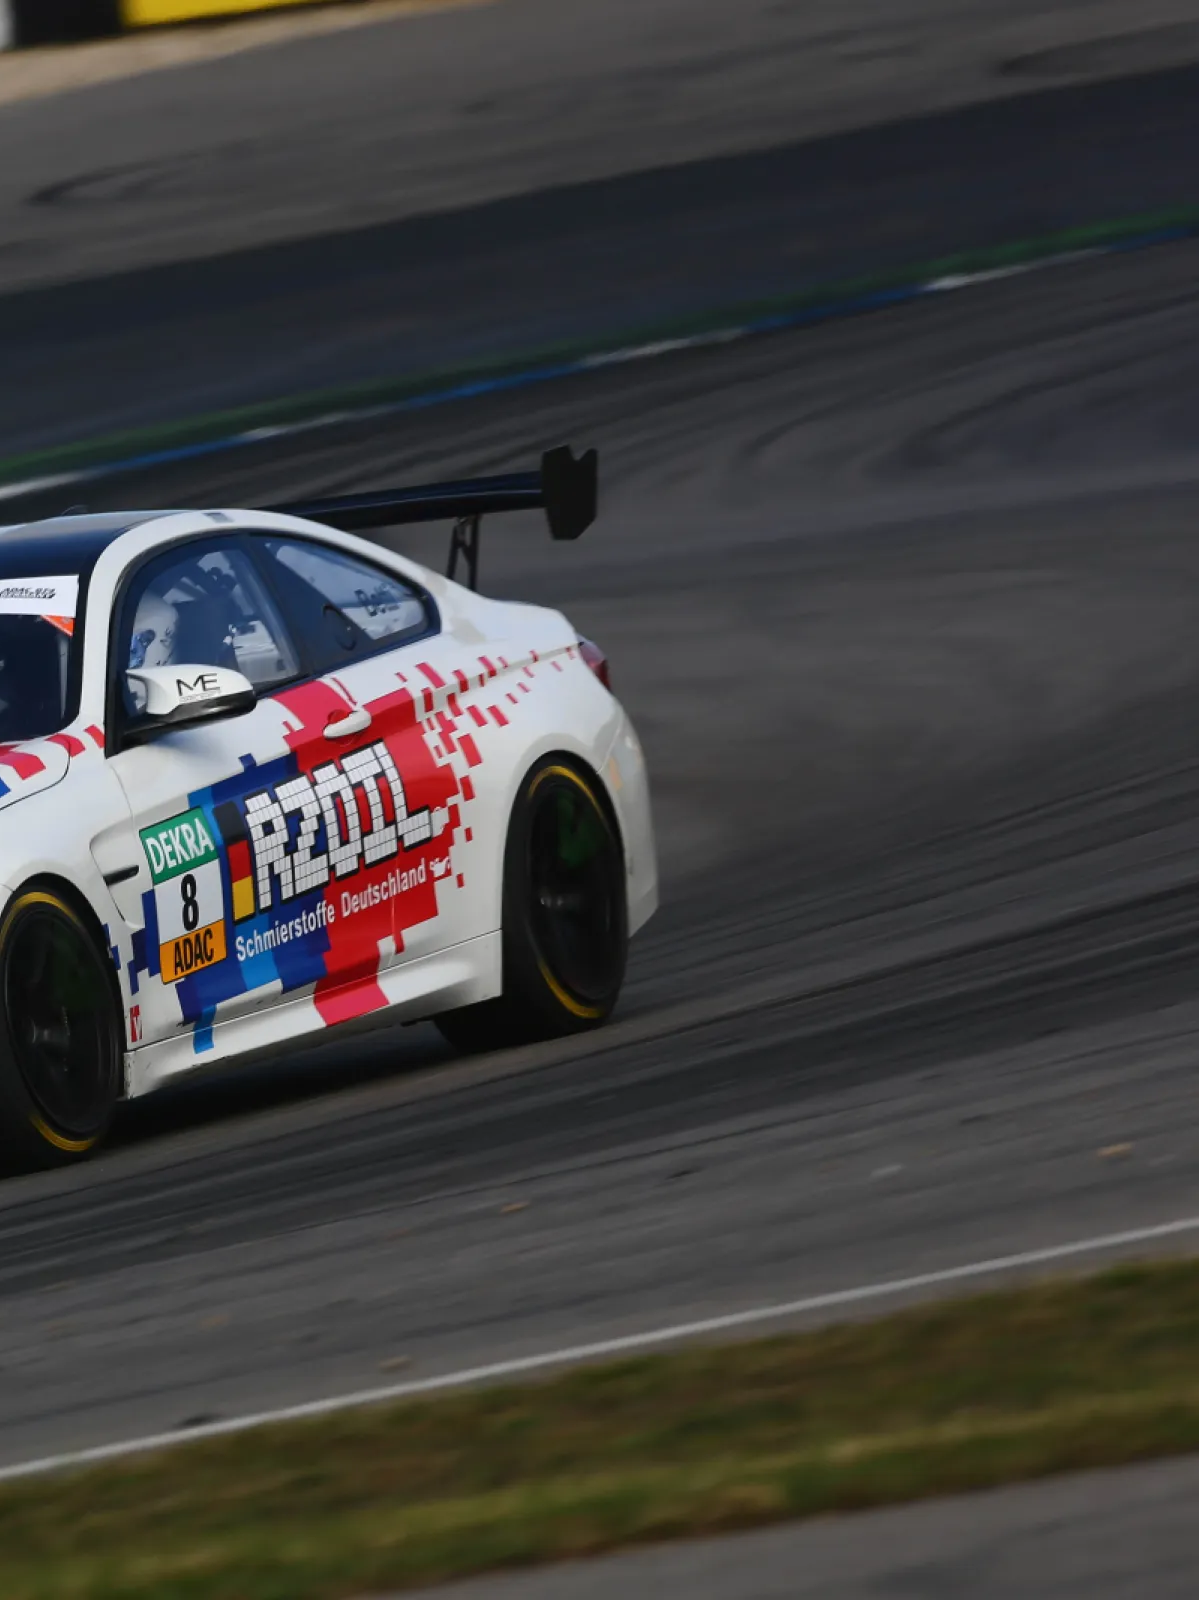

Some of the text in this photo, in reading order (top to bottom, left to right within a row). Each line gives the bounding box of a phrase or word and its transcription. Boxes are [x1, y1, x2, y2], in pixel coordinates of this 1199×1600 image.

[175, 672, 221, 697] ME
[145, 817, 215, 875] DEKRA
[180, 873, 200, 932] 8
[234, 857, 427, 962] Schmierstoffe Deutschland
[173, 927, 215, 976] ADAC
